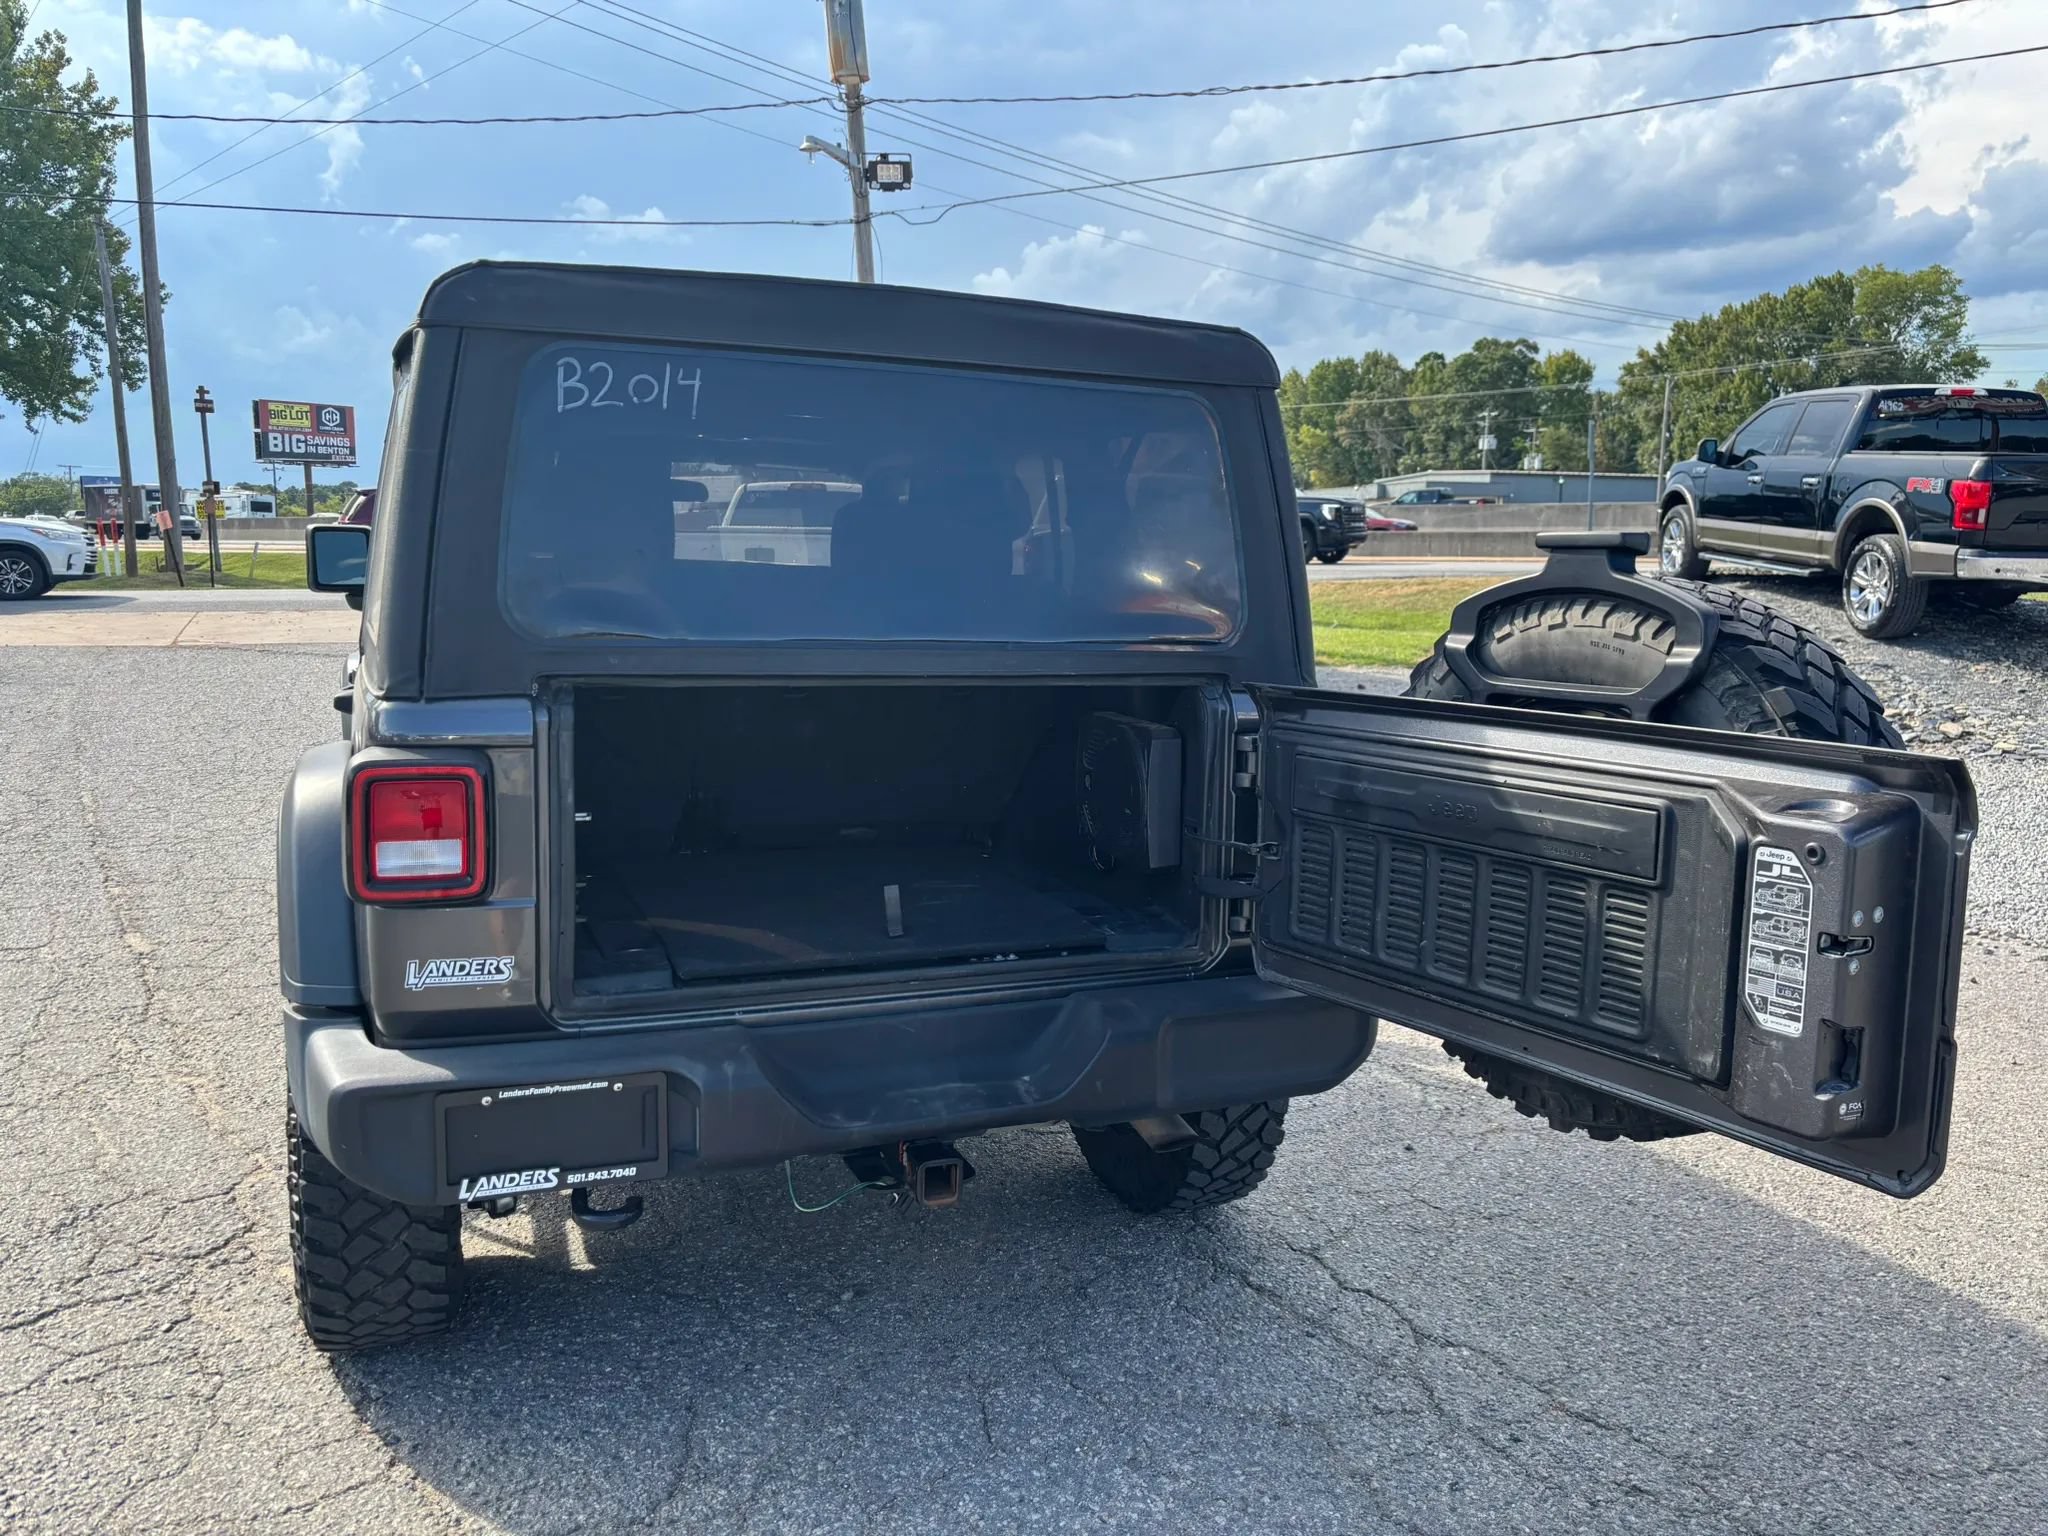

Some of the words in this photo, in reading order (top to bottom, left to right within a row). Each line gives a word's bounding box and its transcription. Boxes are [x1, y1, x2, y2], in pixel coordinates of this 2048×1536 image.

[556, 356, 702, 420] B2014
[1878, 400, 1904, 412] A1962
[269, 408, 288, 420] BIG
[290, 410, 310, 421] LOT
[268, 433, 306, 454] BIG
[306, 435, 351, 447] SAVINGS
[306, 446, 317, 454] IN
[318, 446, 350, 455] BENTON
[1906, 477, 1945, 495] FX4
[1766, 850, 1785, 861] Jeep
[1757, 864, 1804, 879] JL
[406, 957, 513, 990] LANDERS
[1776, 986, 1802, 1000] USA
[458, 1168, 561, 1201] LANDERS
